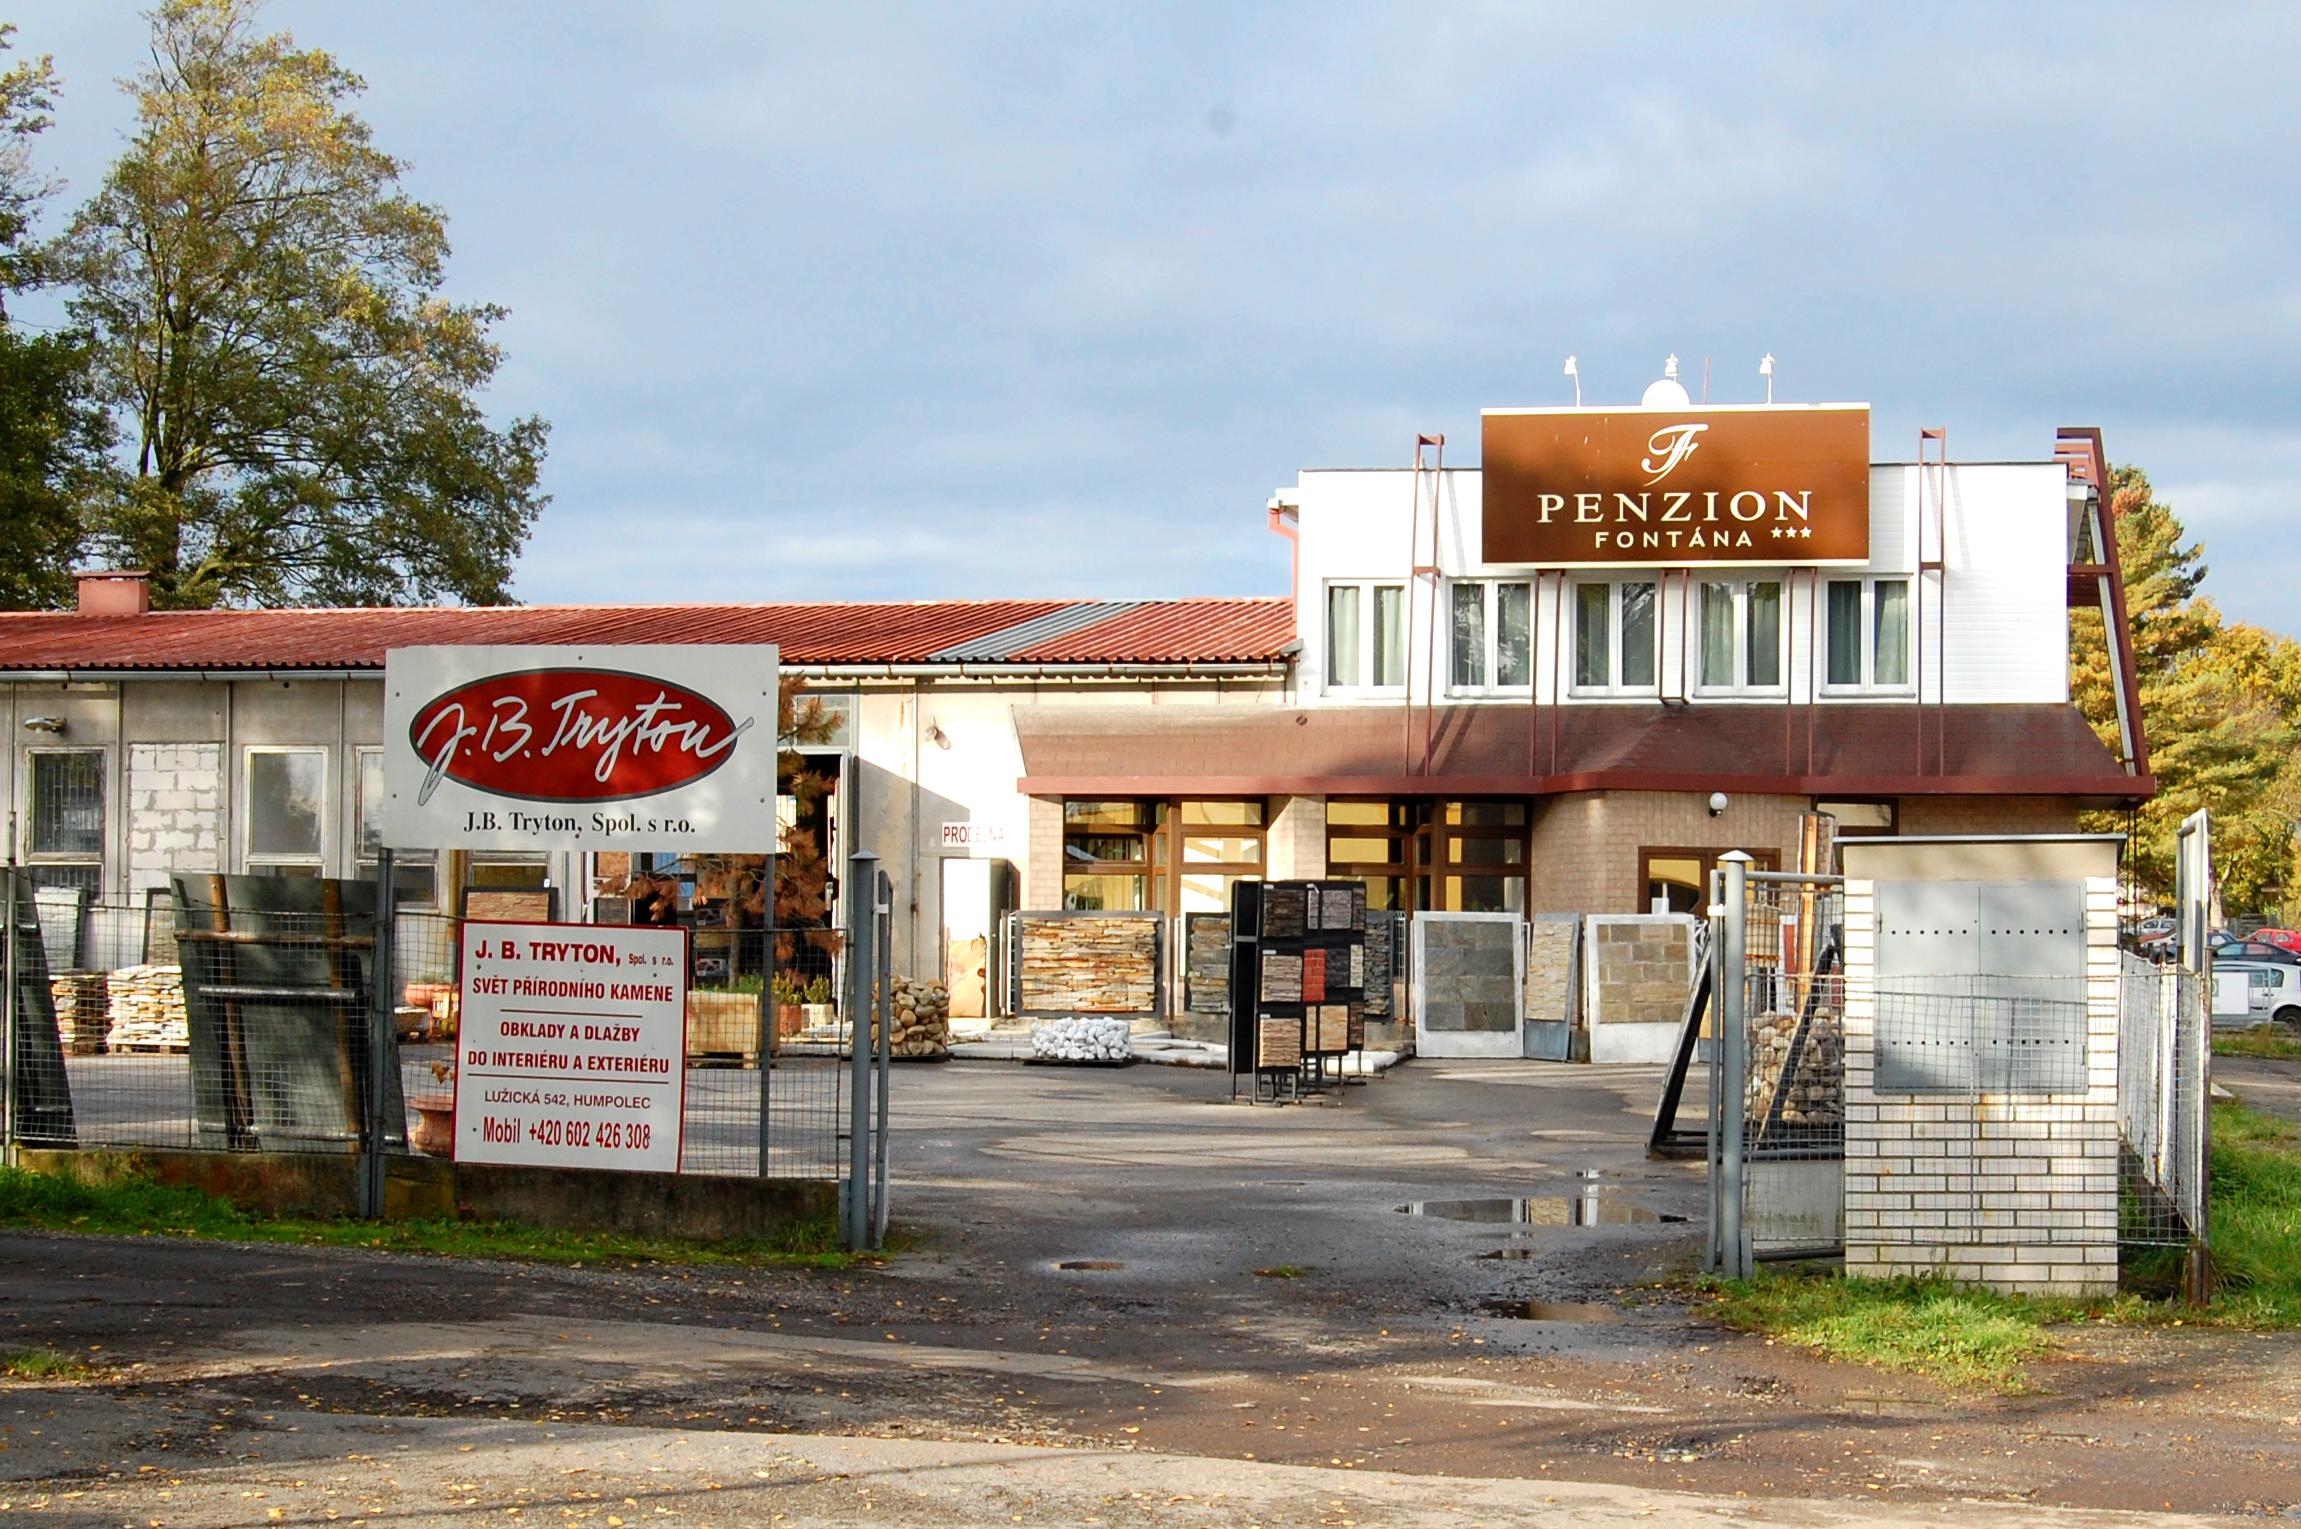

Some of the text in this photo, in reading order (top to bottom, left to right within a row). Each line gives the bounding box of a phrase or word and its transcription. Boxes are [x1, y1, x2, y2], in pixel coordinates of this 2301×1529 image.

[1536, 490, 1813, 524] PENZION
[1595, 526, 1753, 549] FONTÁNA
[541, 689, 754, 783] Tryton
[463, 812, 696, 837] J.B. Tryton, Spol. s r.o.
[943, 825, 1006, 843] PRODENA
[475, 940, 493, 959] J.
[501, 941, 521, 960] B.
[529, 942, 621, 967] TRYTON,
[651, 956, 657, 966] s
[473, 975, 674, 1002] SVĚT PŘÍRODNÍHO KAMENE
[500, 1021, 640, 1042] OBKLADY A DLAŽBY
[468, 1049, 669, 1073] DO INTERIÉRU A EXTERIÉRU
[484, 1088, 651, 1109] LUŽICKÁ 542, HUMPOLEC
[483, 1116, 651, 1150] Mobil +420 602 426 308
